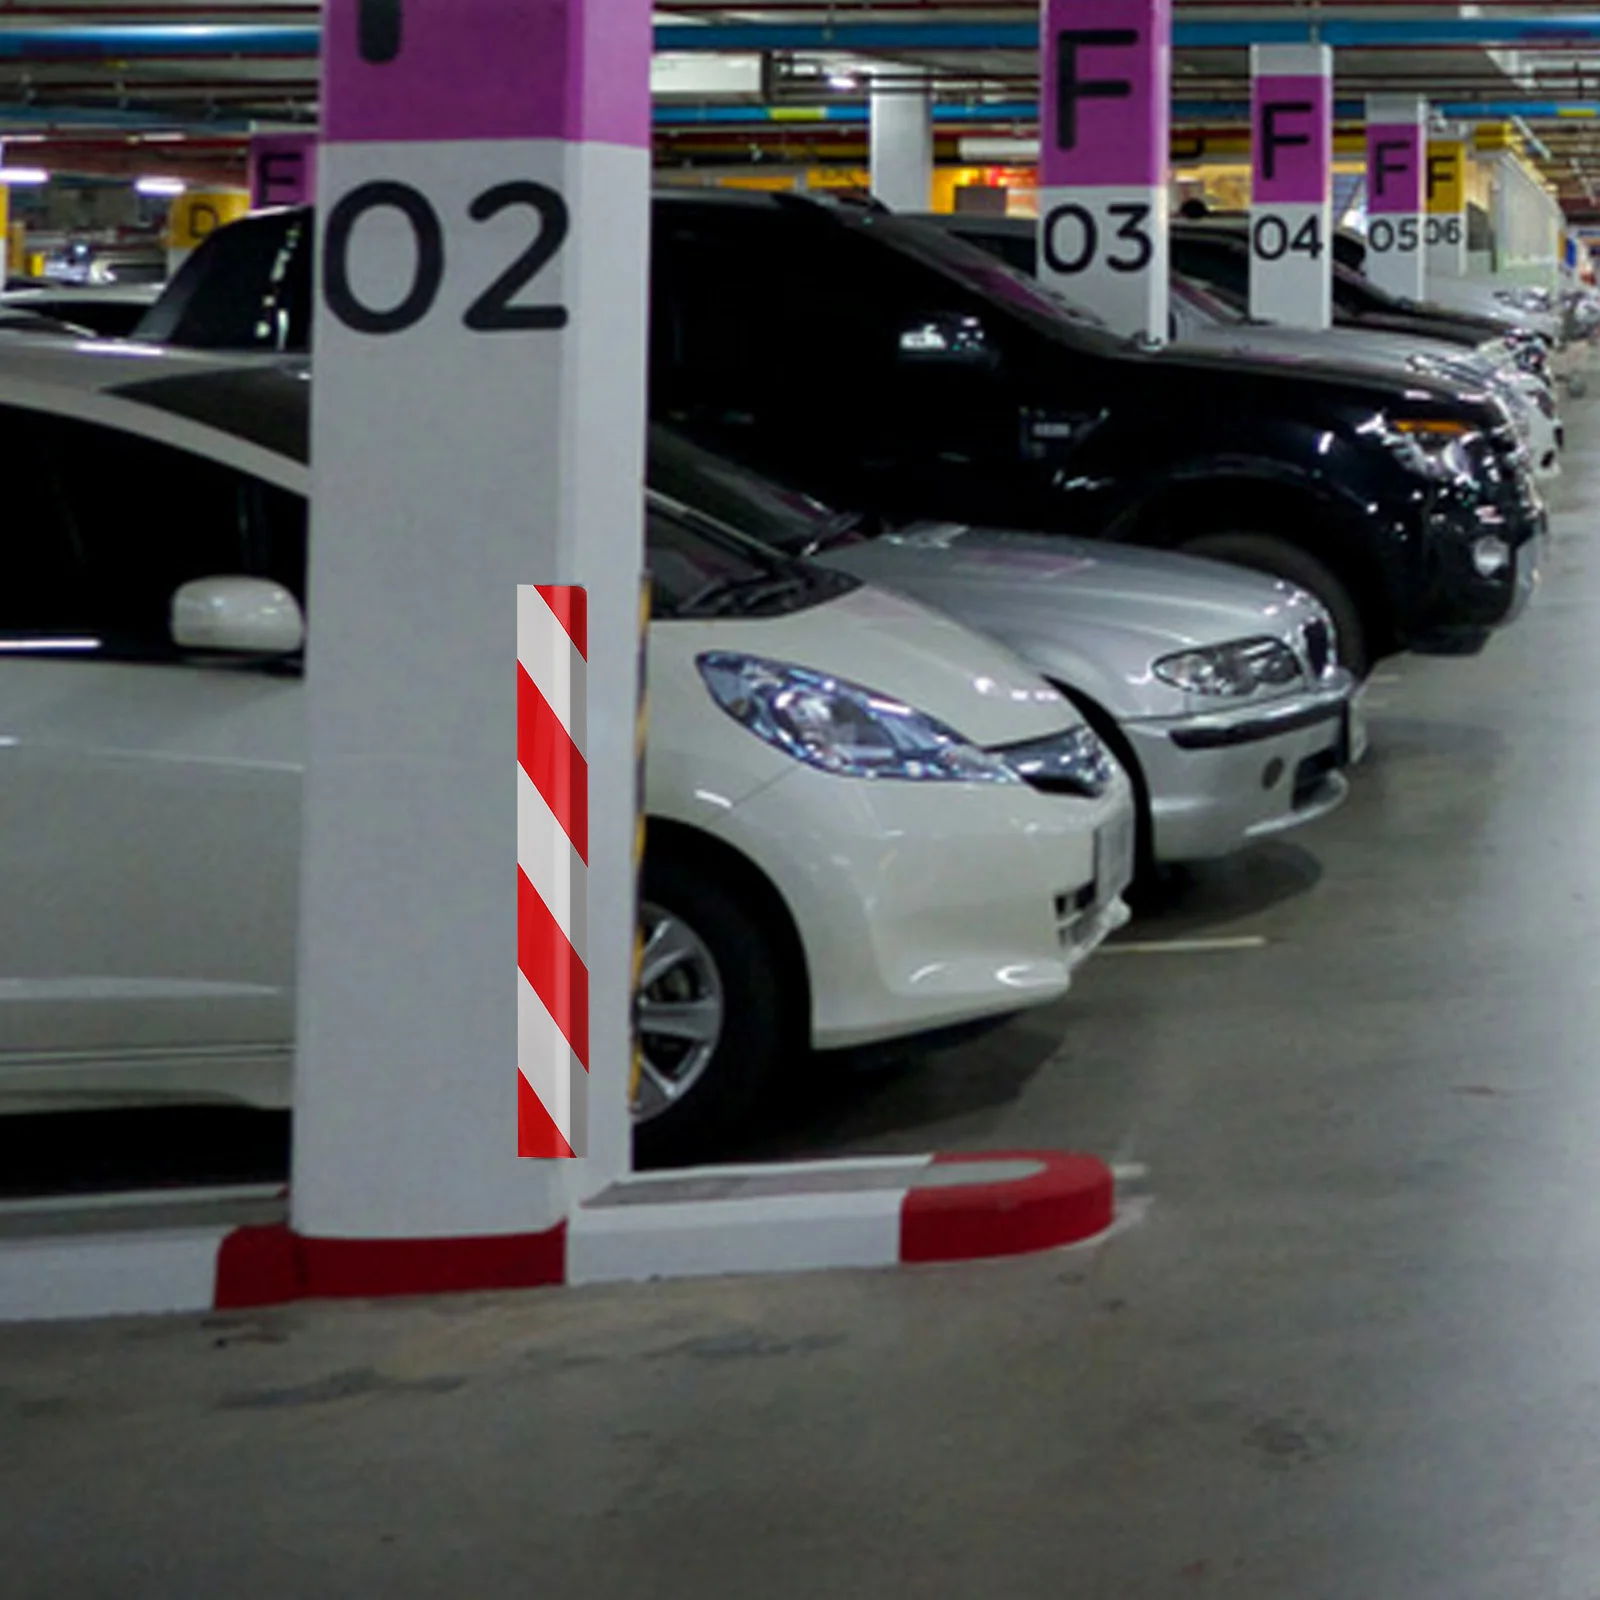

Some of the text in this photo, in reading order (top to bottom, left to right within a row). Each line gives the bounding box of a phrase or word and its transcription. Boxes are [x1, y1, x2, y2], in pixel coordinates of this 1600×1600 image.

[1057, 29, 1138, 151] F
[1261, 102, 1313, 181] F
[1376, 140, 1411, 196] F
[1426, 156, 1457, 199] F
[189, 203, 219, 239] D
[1044, 204, 1153, 274] 03
[1253, 214, 1324, 261] 04
[1369, 217, 1418, 252] 05
[1424, 217, 1461, 245] 06
[322, 180, 569, 334] 02
